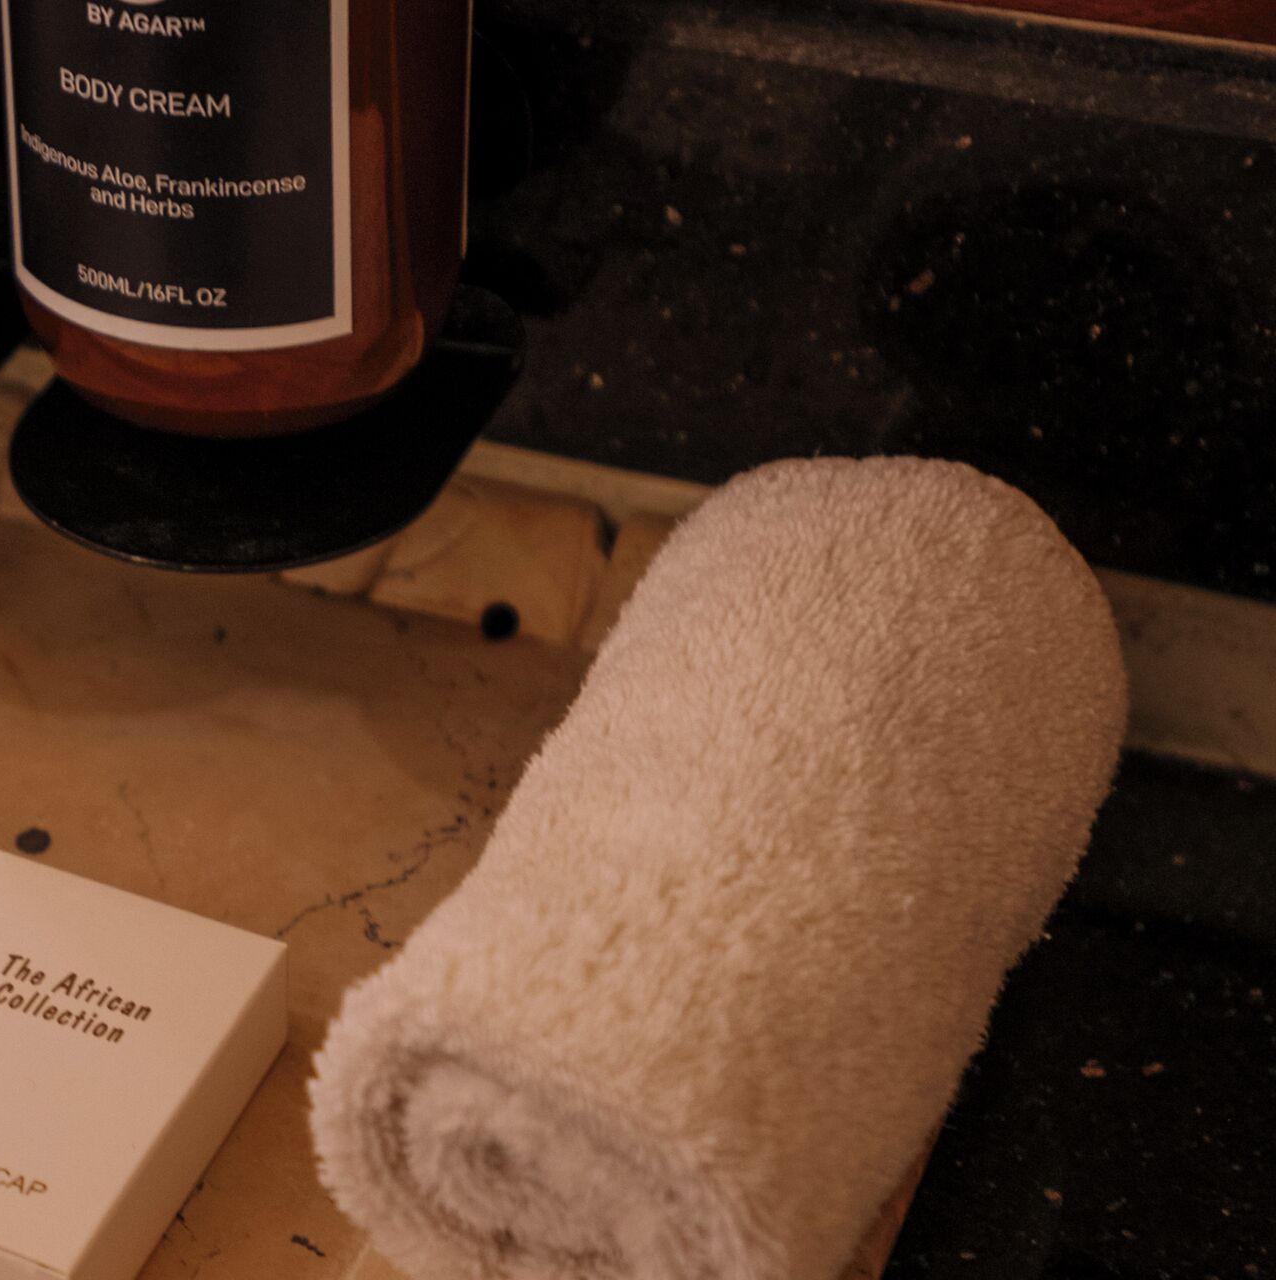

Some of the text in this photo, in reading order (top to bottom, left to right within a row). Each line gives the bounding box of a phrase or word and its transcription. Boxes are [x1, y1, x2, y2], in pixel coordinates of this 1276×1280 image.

[87, 2, 114, 26] BY
[60, 67, 231, 118] BODY CREAM
[102, 164, 151, 194] Aloe,
[155, 174, 306, 200] Frankincense
[91, 186, 194, 219] and Herbs
[78, 264, 227, 308] 500ML/16FL OZ
[0, 954, 153, 1022] The African
